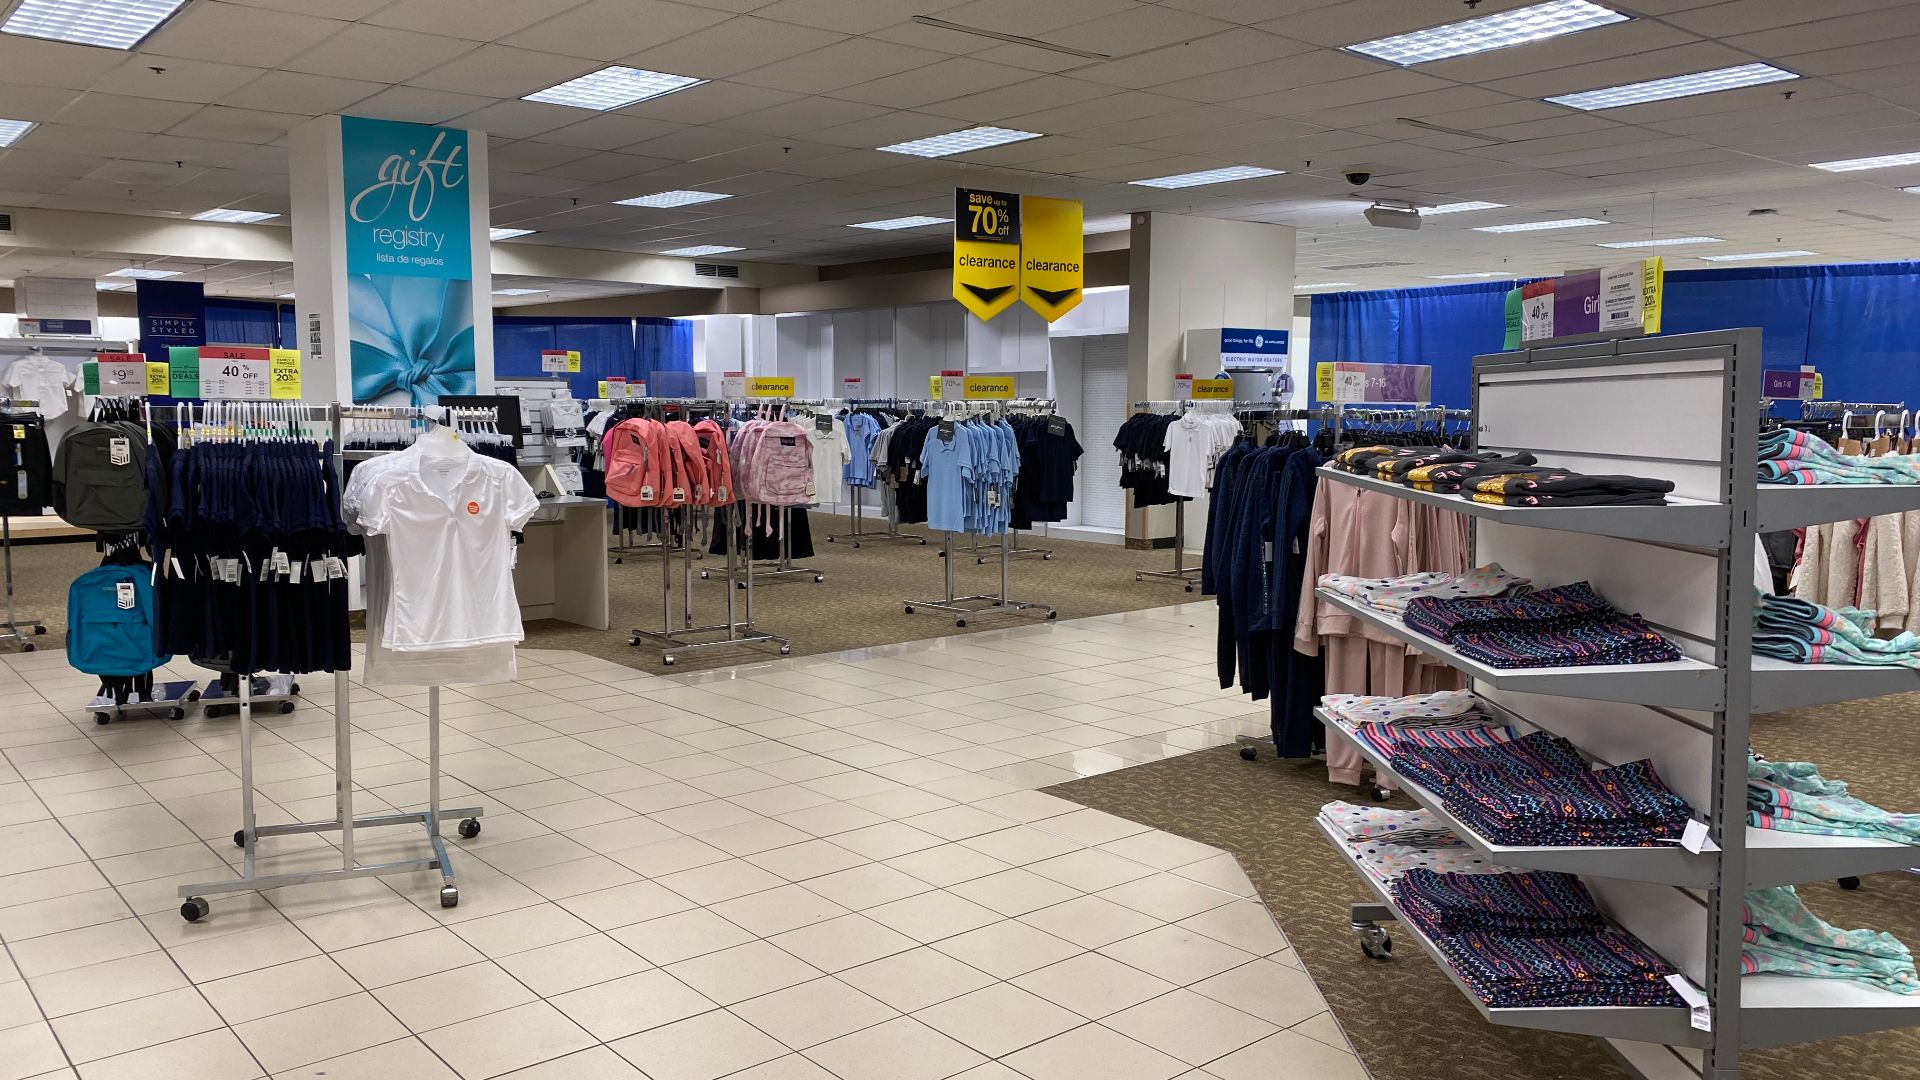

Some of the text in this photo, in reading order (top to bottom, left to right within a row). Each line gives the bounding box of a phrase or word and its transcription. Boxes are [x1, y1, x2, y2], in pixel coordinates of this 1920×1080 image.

[350, 131, 464, 223] gift
[969, 193, 993, 205] save
[997, 225, 1010, 236] off
[373, 225, 445, 252] registry
[376, 252, 444, 266] lista de regalos
[959, 253, 1016, 270] clearance
[1026, 258, 1080, 273] clearance
[1540, 311, 1549, 320] OFF
[152, 319, 193, 327] SIMPLY
[151, 326, 195, 334] STYLED
[223, 352, 246, 360] SALE
[751, 382, 789, 391] clearance
[969, 383, 1009, 392] clearance
[1371, 377, 1386, 389] 7-16
[1197, 385, 1229, 393] clearance
